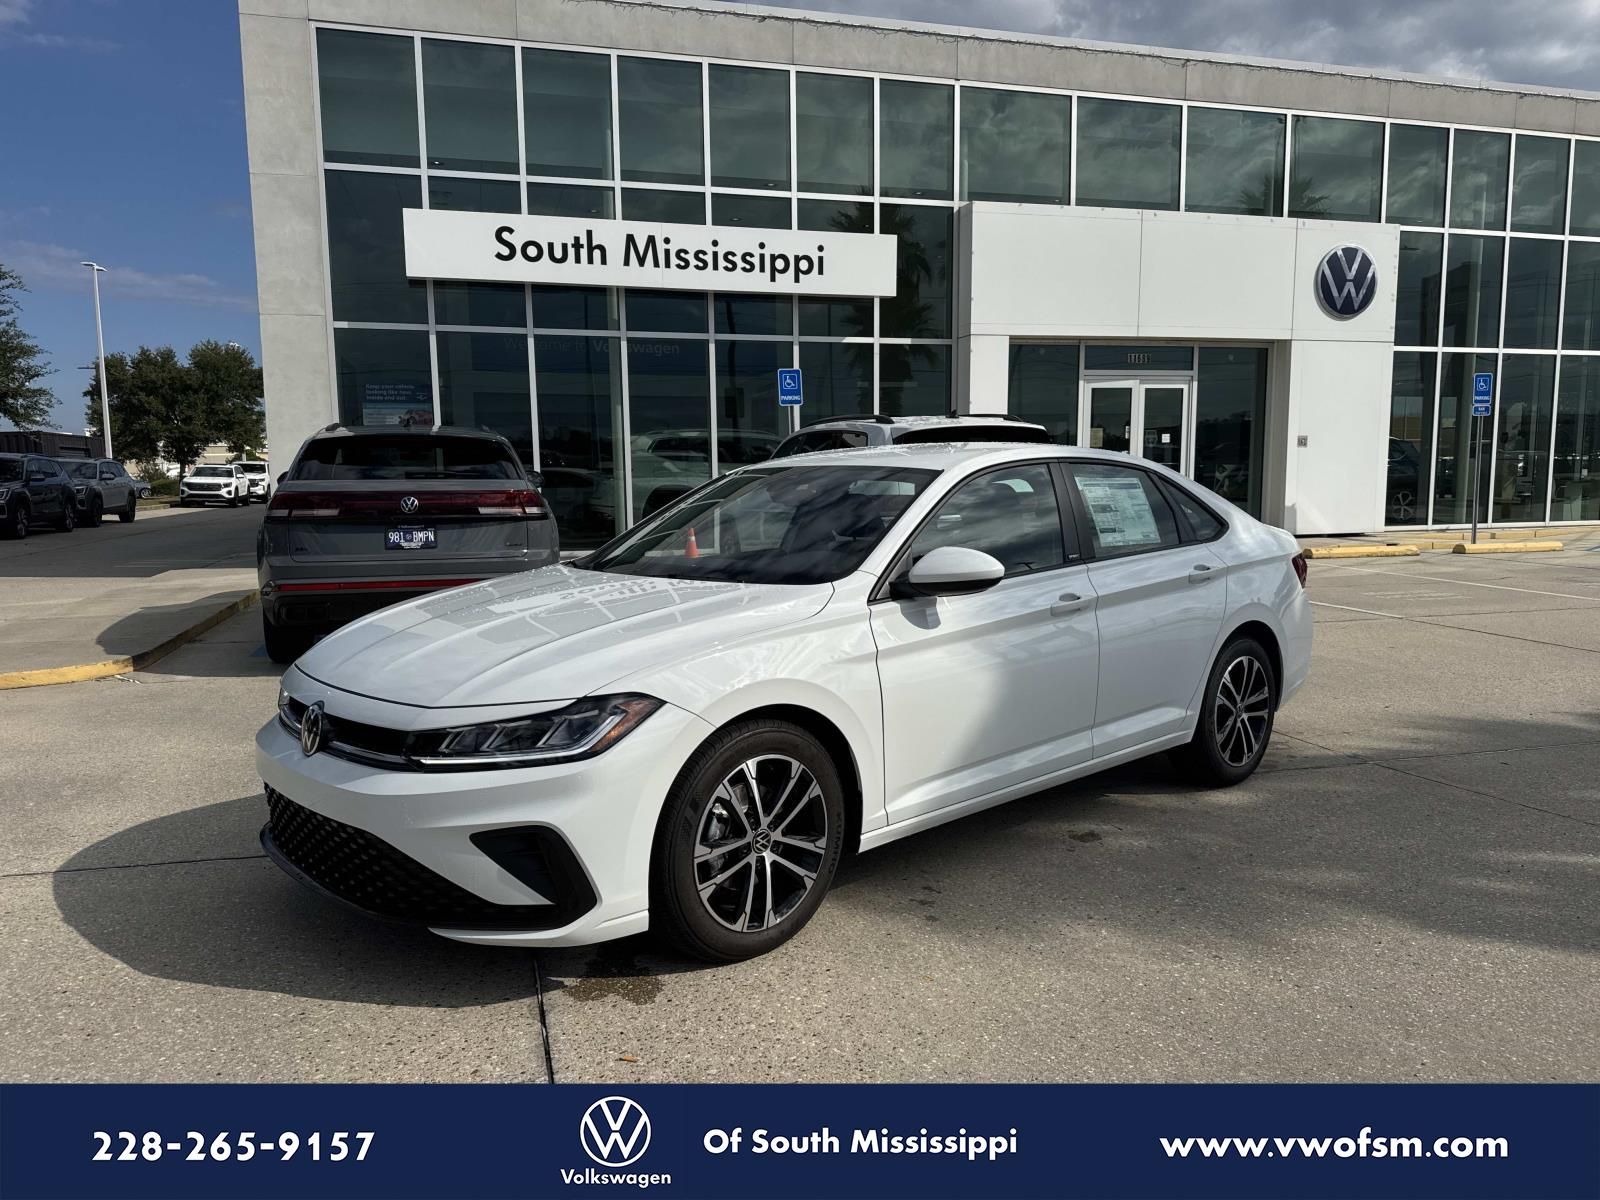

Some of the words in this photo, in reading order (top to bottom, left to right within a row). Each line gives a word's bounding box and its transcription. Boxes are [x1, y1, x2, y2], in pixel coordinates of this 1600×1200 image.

[494, 225, 608, 266] South
[623, 233, 825, 284] Mississippi
[388, 531, 405, 543] 981
[412, 530, 435, 542] BMPN
